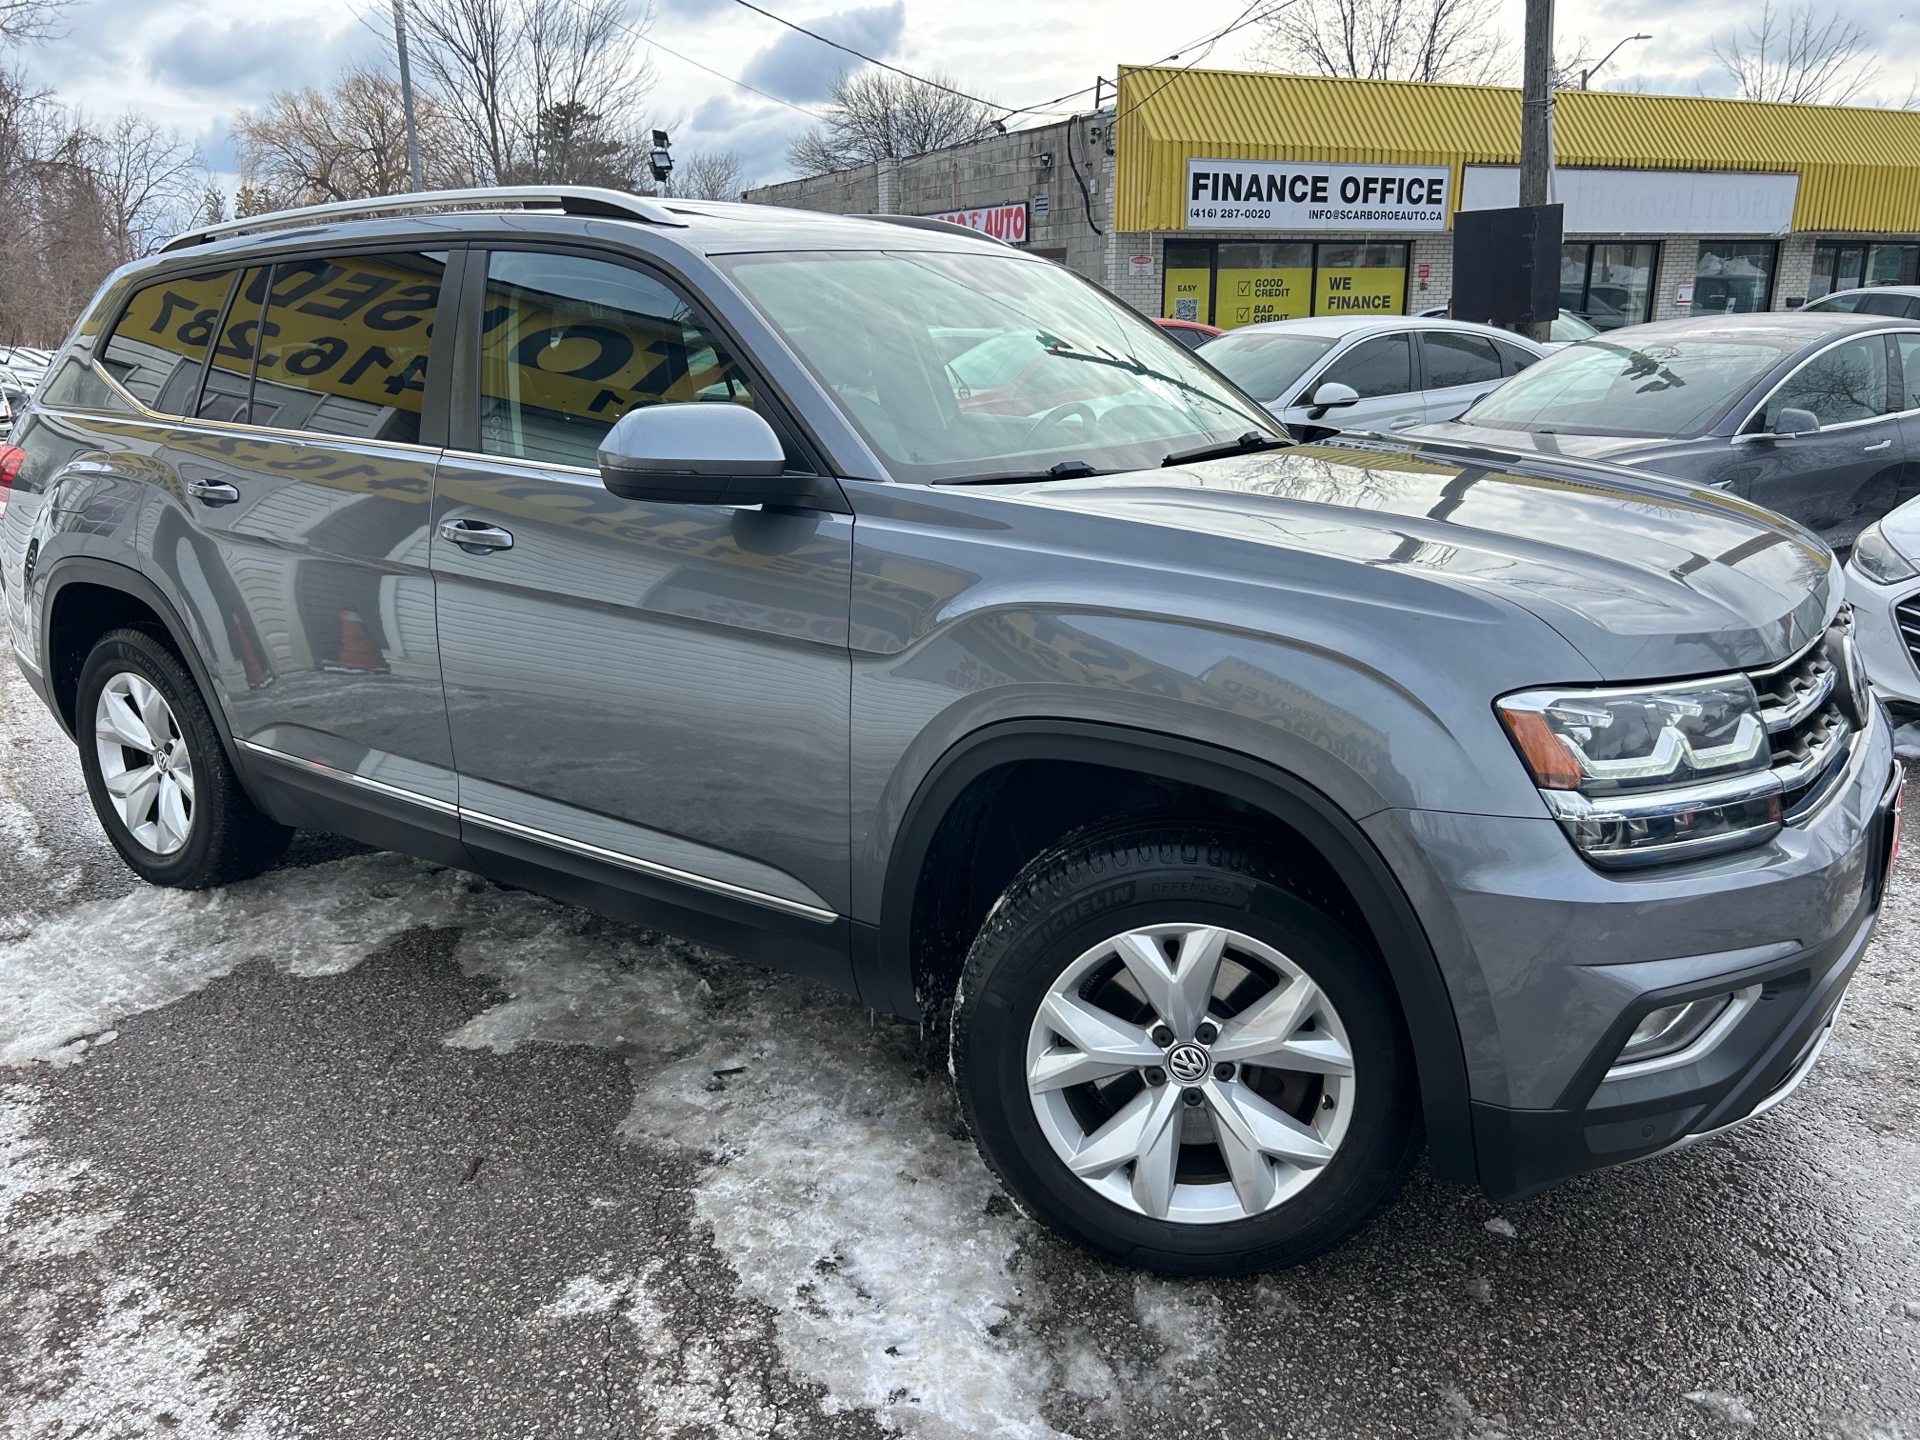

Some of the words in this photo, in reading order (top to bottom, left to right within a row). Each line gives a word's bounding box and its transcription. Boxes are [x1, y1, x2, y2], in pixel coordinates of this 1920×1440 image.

[1192, 172, 1329, 204] FINANCE
[1339, 175, 1444, 206] OFFICE
[1189, 208, 1218, 219] (416)
[1220, 208, 1271, 219] 287-0020
[1308, 209, 1443, 222] INFO@SCARBOROEAUTO.CA
[984, 206, 1025, 240] AUTO
[1177, 284, 1197, 292] EASY
[1255, 278, 1284, 288] GOOD
[1328, 276, 1352, 291] WE
[1254, 287, 1291, 298] CREDIT
[1253, 304, 1274, 314] BAD
[1327, 295, 1391, 310] FINANCE
[1253, 313, 1290, 324] CREDIT
[133, 653, 175, 700] MICHELIN
[1025, 886, 1131, 954] MICHELIN
